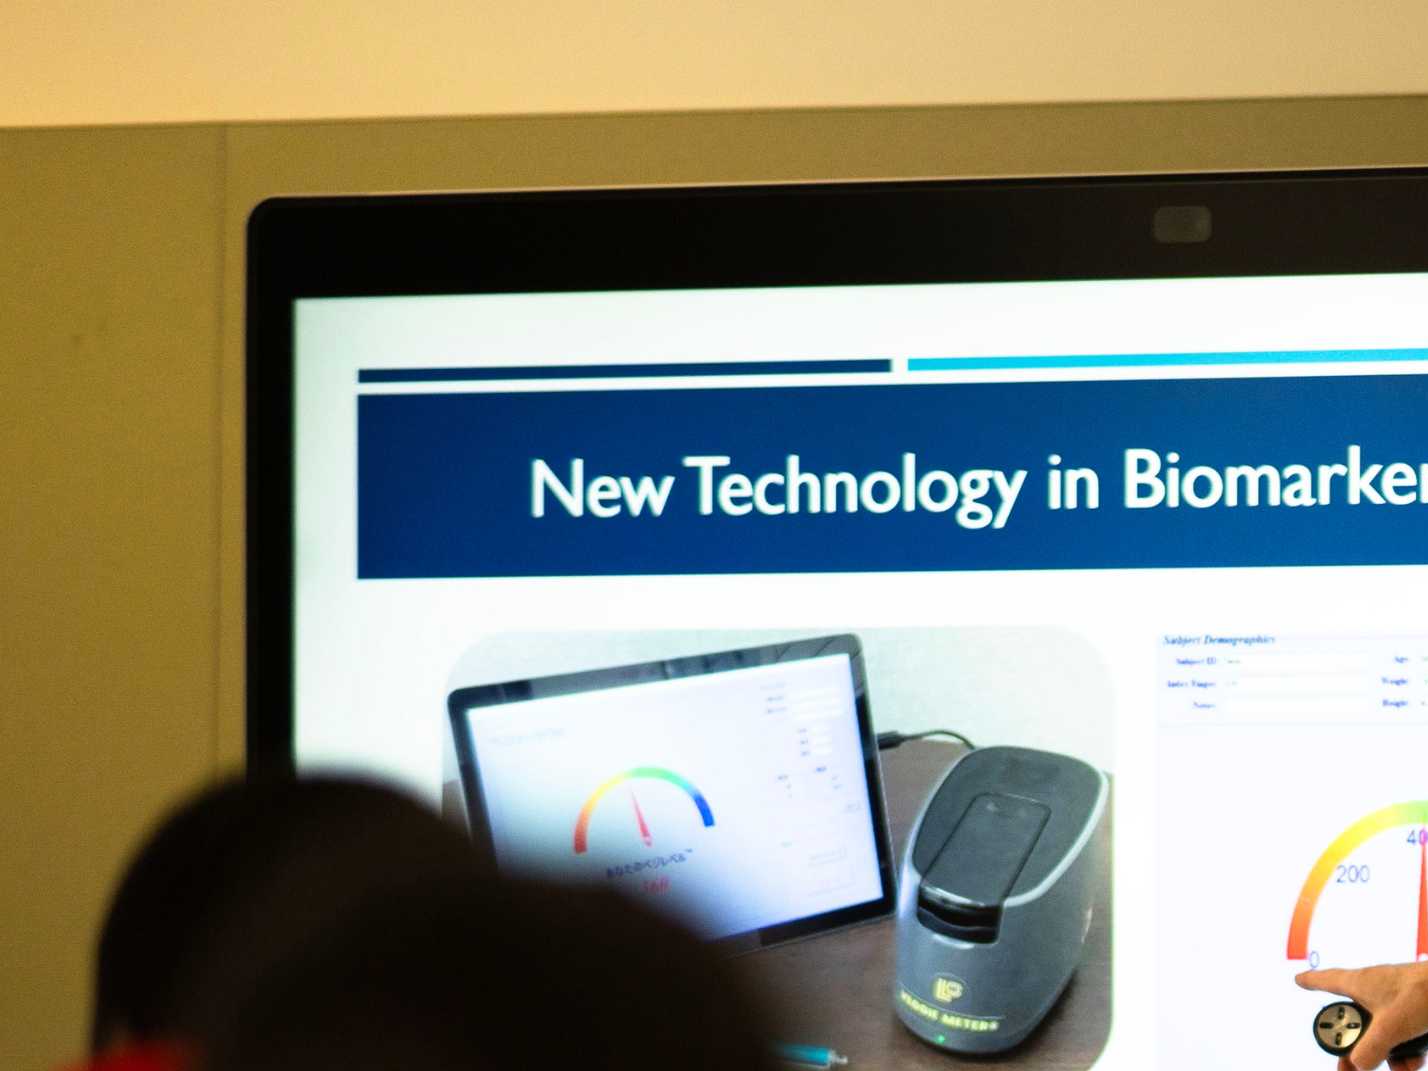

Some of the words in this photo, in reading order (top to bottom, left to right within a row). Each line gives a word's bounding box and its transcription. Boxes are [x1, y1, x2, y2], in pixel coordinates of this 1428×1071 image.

[530, 457, 675, 519] New
[684, 452, 1028, 529] Technology
[1047, 453, 1100, 511] in
[1335, 864, 1371, 884] 200
[1308, 951, 1320, 969] 0
